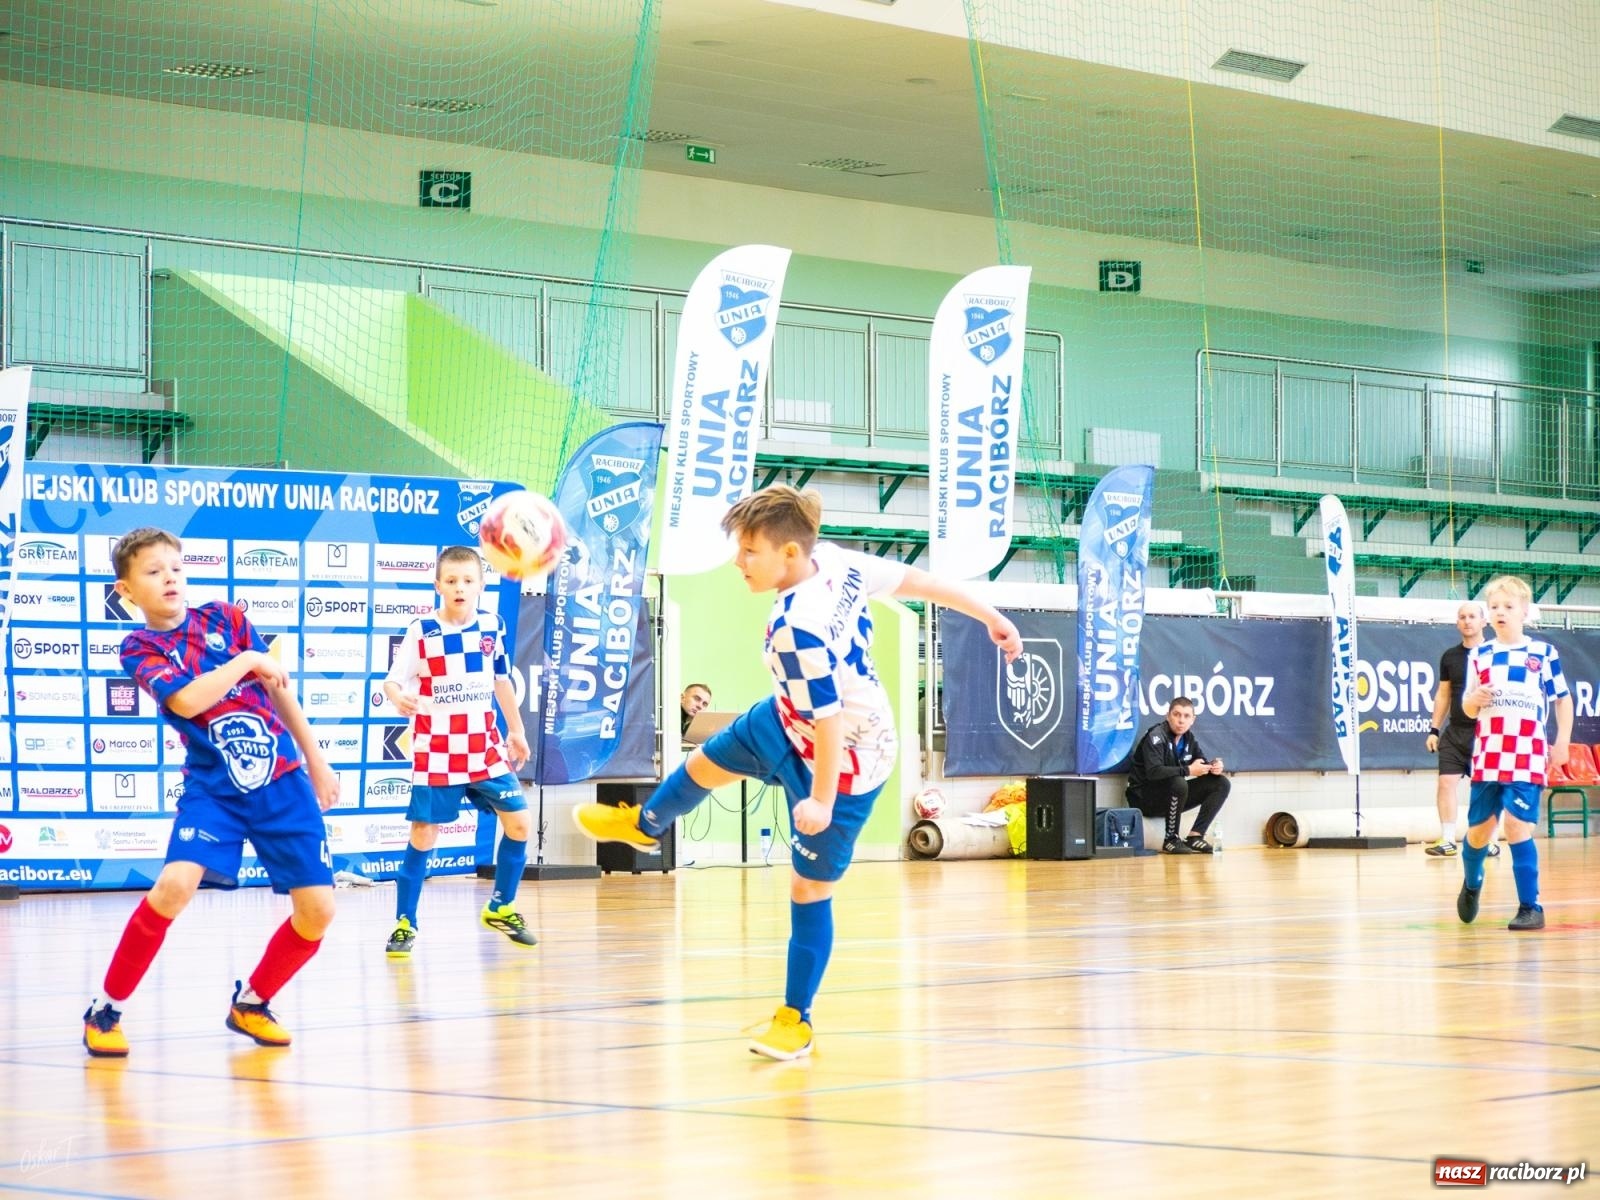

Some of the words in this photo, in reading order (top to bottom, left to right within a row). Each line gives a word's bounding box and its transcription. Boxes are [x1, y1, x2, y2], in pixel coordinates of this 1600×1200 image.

[430, 182, 460, 203] C
[1108, 271, 1134, 288] D
[720, 304, 762, 325] UNIA
[967, 321, 1006, 345] UNIA
[681, 350, 700, 426] SPORTOWY
[940, 373, 952, 444] SPORTOWY
[676, 430, 689, 467] KLUB
[692, 389, 730, 498] UNIA
[725, 358, 760, 506] ACIBÓRZ
[595, 457, 641, 470] RACIBORZ
[939, 448, 949, 483] KLUB
[956, 404, 985, 508] UNIA
[986, 374, 1012, 538] RACIBÓRZ
[25, 473, 95, 503] IEJSKI
[101, 476, 159, 505] KLUB
[164, 479, 279, 509] SPORTOWY
[284, 484, 335, 511] UNIA
[340, 483, 440, 515] RACIBÓRZ
[591, 486, 636, 513] UNIA
[669, 471, 685, 528] MIEJSKI
[460, 502, 489, 522] UNIA
[937, 486, 949, 539] MIEJSKI
[1108, 519, 1137, 541] UNIA
[19, 547, 78, 561] GROTEAM
[14, 594, 43, 605] BOXY
[554, 546, 572, 626] SPORTOWY
[1086, 567, 1097, 638] SPORTOWY
[252, 600, 280, 609] Marco
[281, 599, 295, 609] Oil
[325, 601, 367, 613] SPORT
[34, 642, 80, 656] SPORT
[552, 630, 563, 670] KLUB
[566, 583, 605, 702] UNIA
[600, 548, 636, 740] RACIBÓRZ
[1085, 641, 1093, 675] KLUB
[1094, 600, 1118, 701] UNIA
[433, 683, 463, 695] BIURO
[544, 674, 559, 735] MIEJSKI
[1082, 680, 1091, 731] MIEJSKI
[1382, 714, 1433, 733] RACIBÓR
[109, 739, 138, 749] Marco
[139, 738, 153, 749] Oil
[318, 739, 331, 749] XY
